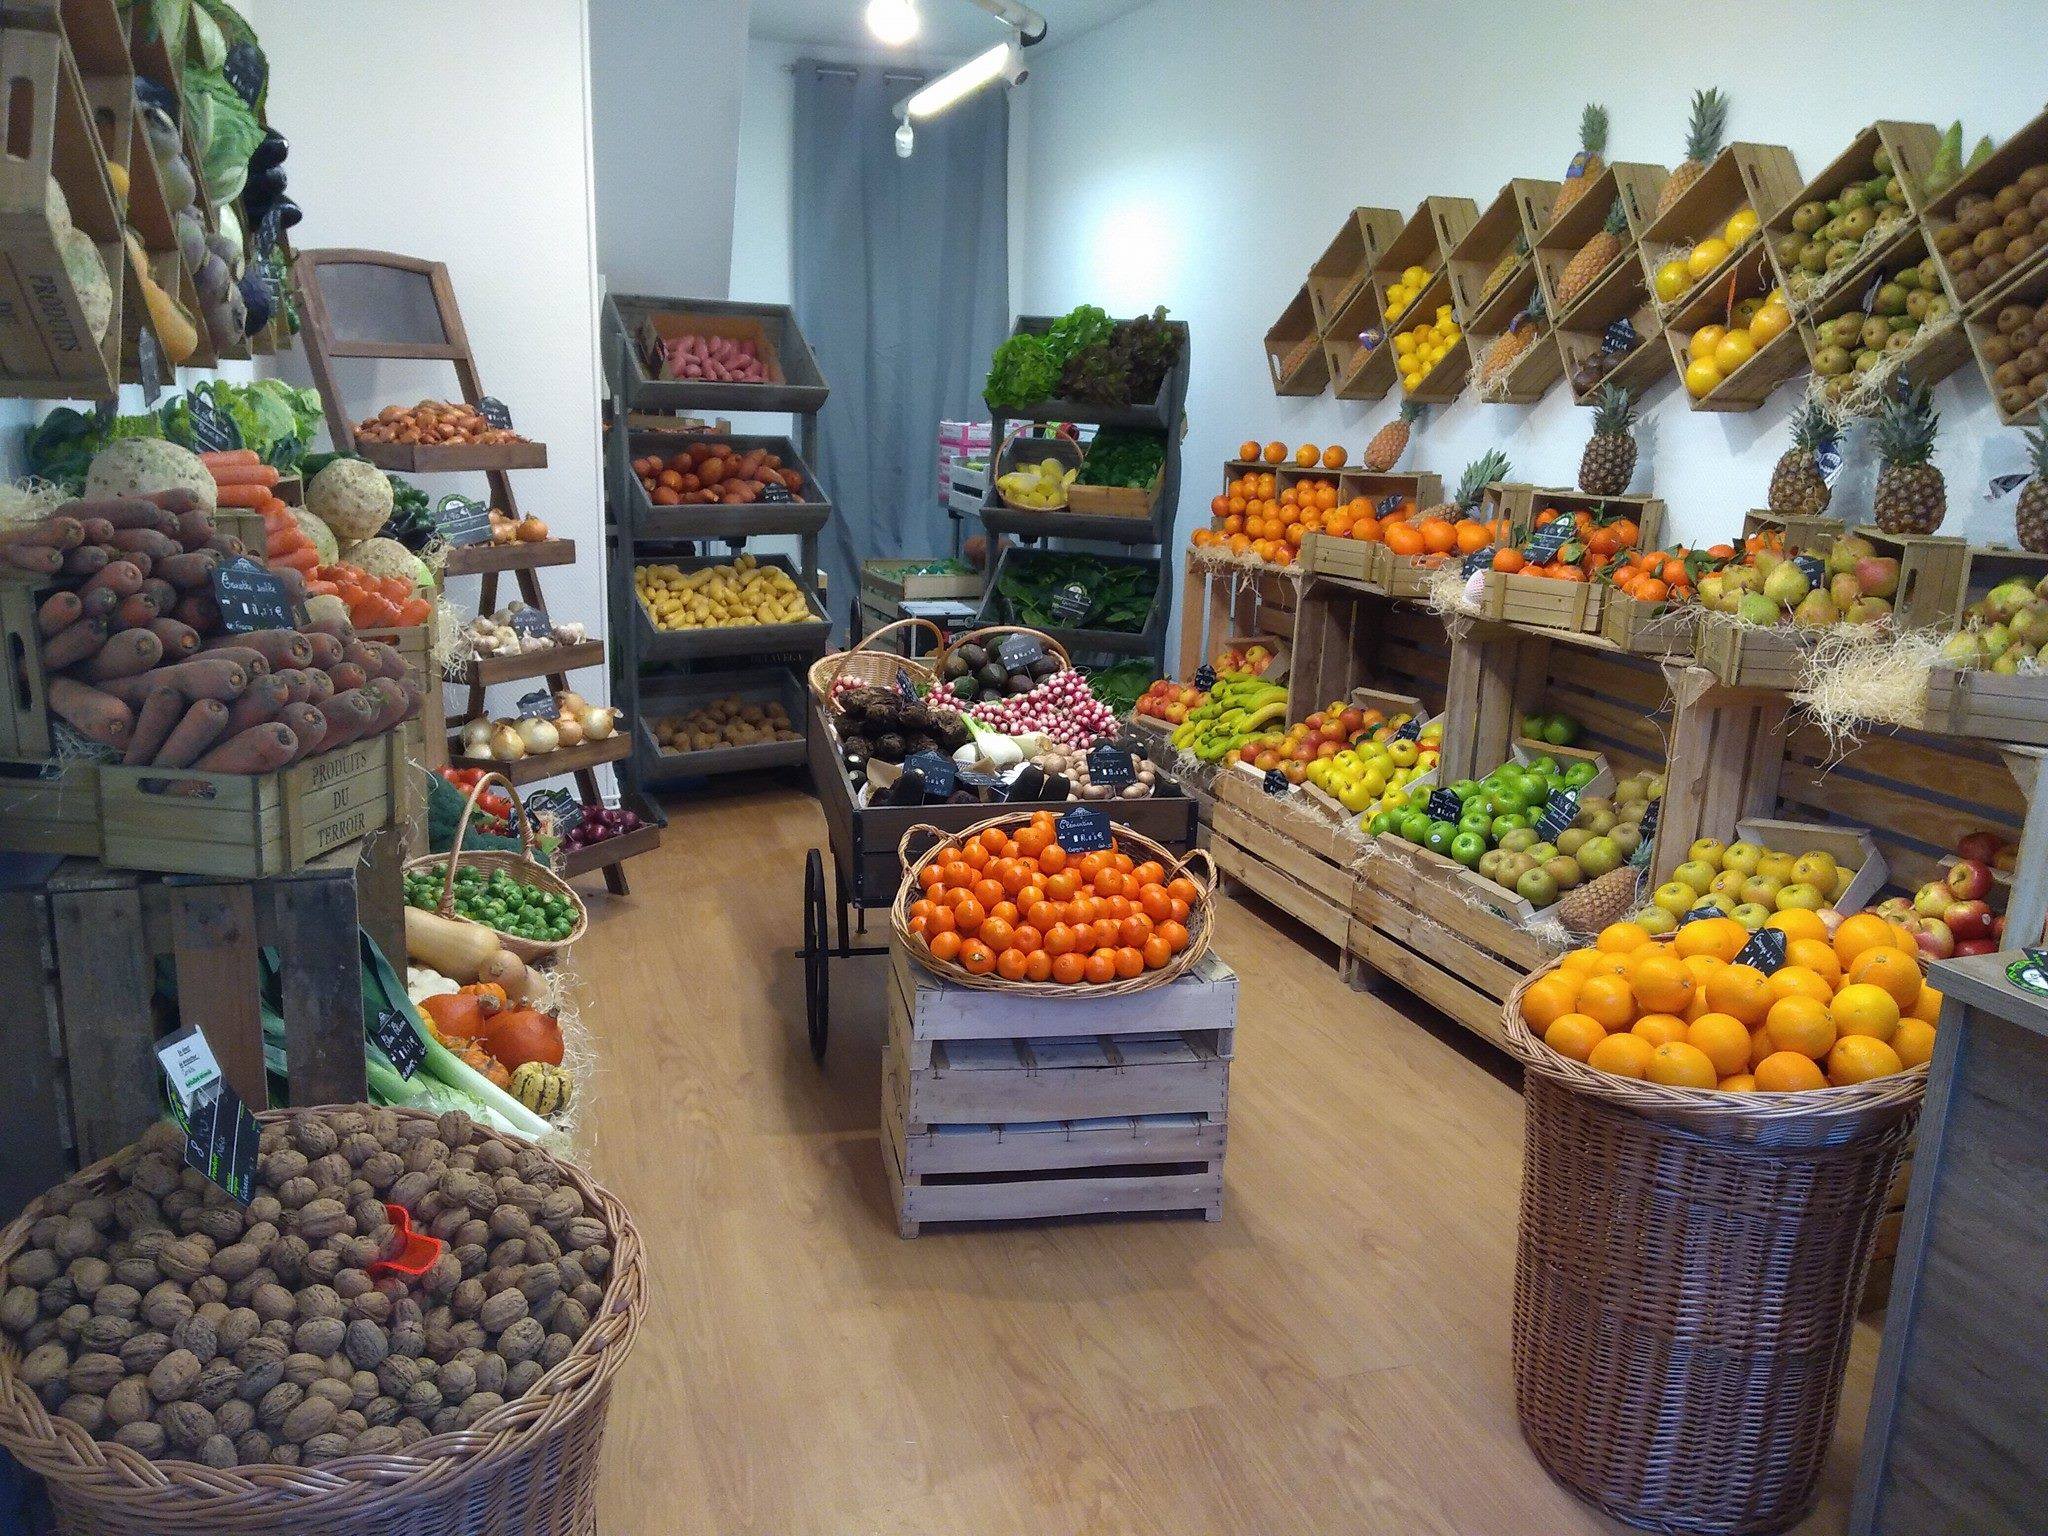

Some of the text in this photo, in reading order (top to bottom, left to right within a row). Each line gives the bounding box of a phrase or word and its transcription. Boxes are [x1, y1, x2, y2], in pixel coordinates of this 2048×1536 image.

[312, 750, 368, 786] PRODUITS
[333, 787, 350, 810] DU
[317, 812, 366, 848] TERROIR
